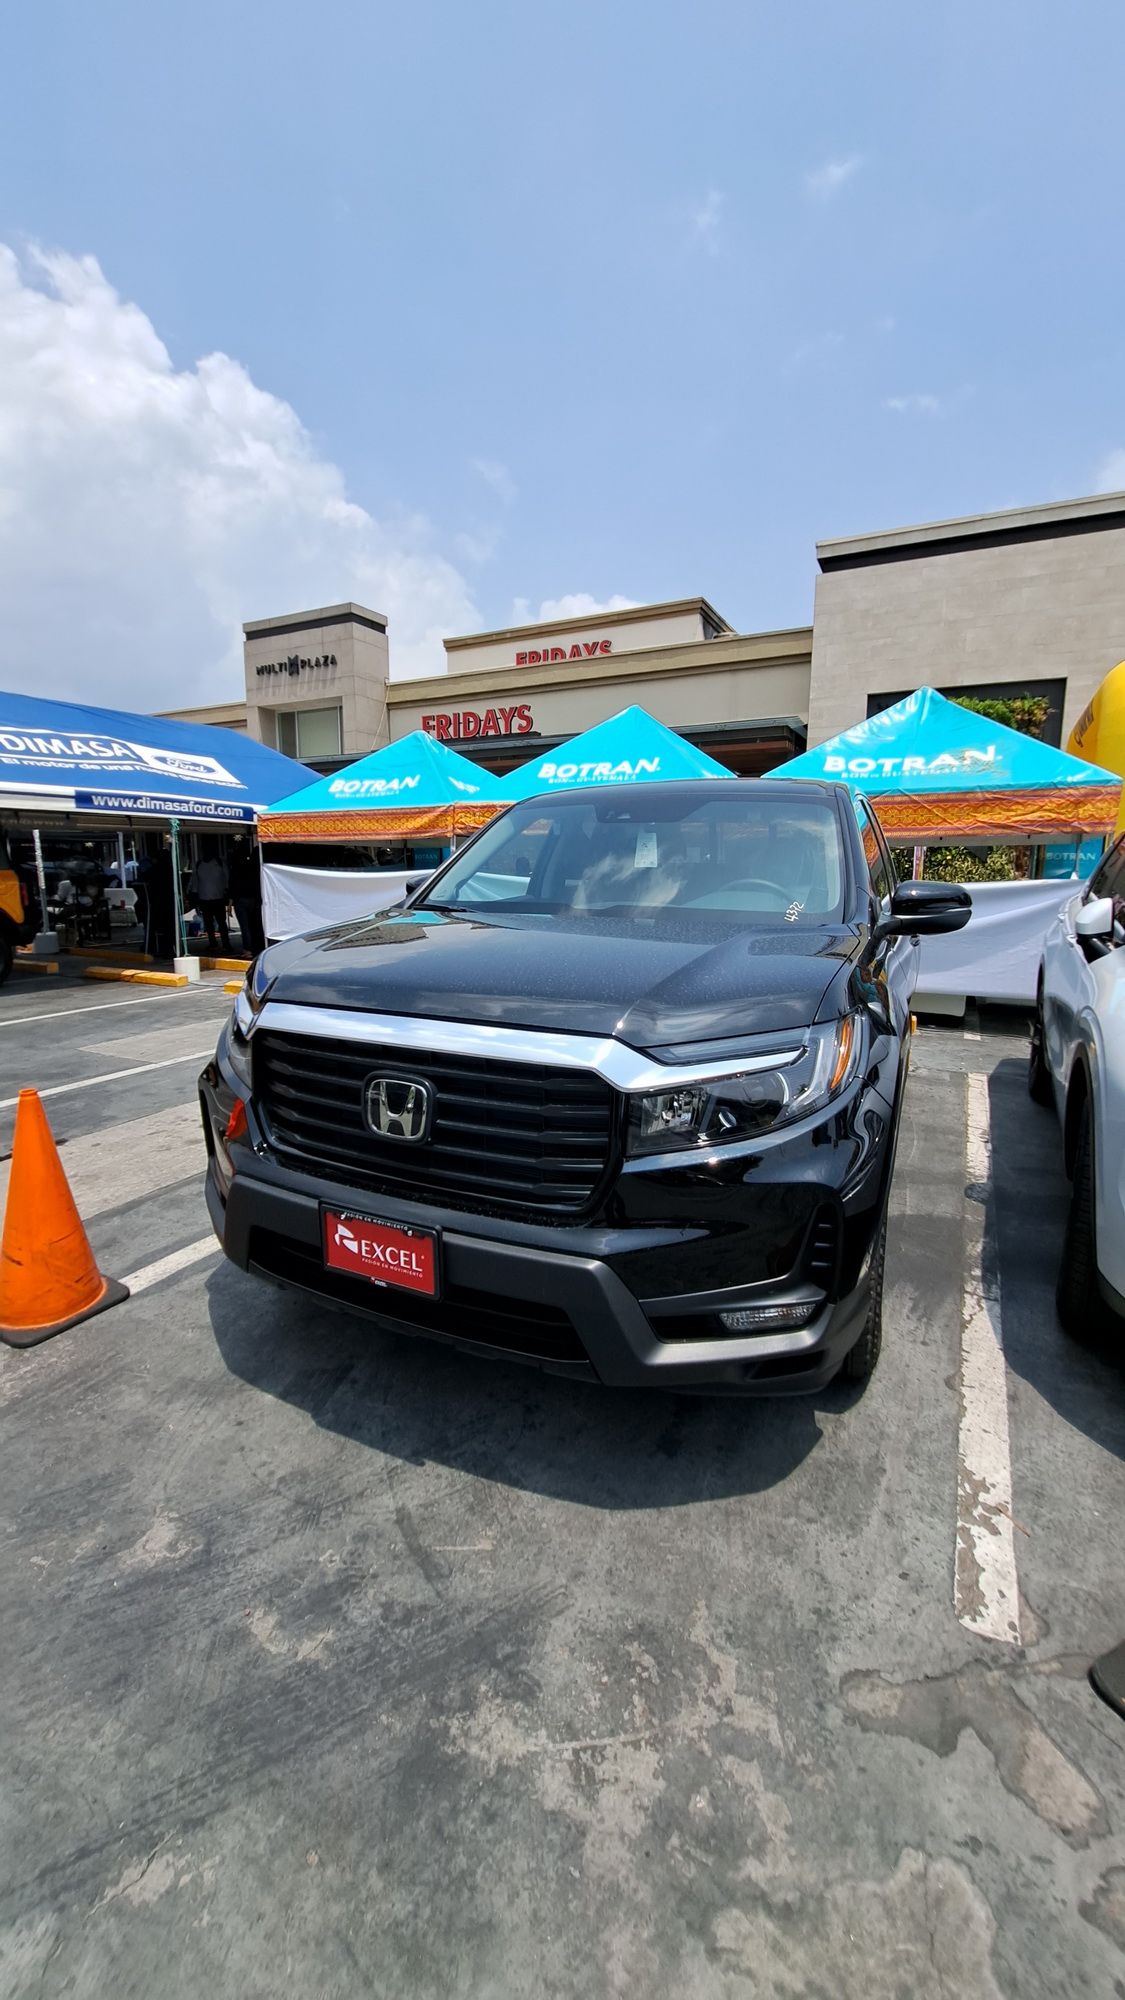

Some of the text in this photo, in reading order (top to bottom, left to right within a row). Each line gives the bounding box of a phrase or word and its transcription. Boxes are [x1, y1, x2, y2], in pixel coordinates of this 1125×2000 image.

[421, 704, 534, 740] FRIDAYS
[0, 733, 137, 759] DIMASA
[22, 760, 77, 769] motor
[78, 763, 102, 771] de
[165, 757, 209, 774] Ford
[537, 757, 660, 778] BOTRAN
[822, 745, 997, 773] BOTRAN
[328, 775, 421, 793] BOTRAN
[576, 774, 637, 783] GUATEMALA
[91, 795, 244, 818] www.dimasaford.com
[1046, 852, 1097, 860] BOTRAN
[783, 901, 805, 922] 4372
[361, 1239, 423, 1272] EXCEL
[389, 1264, 423, 1279] MOVIMIENTO
